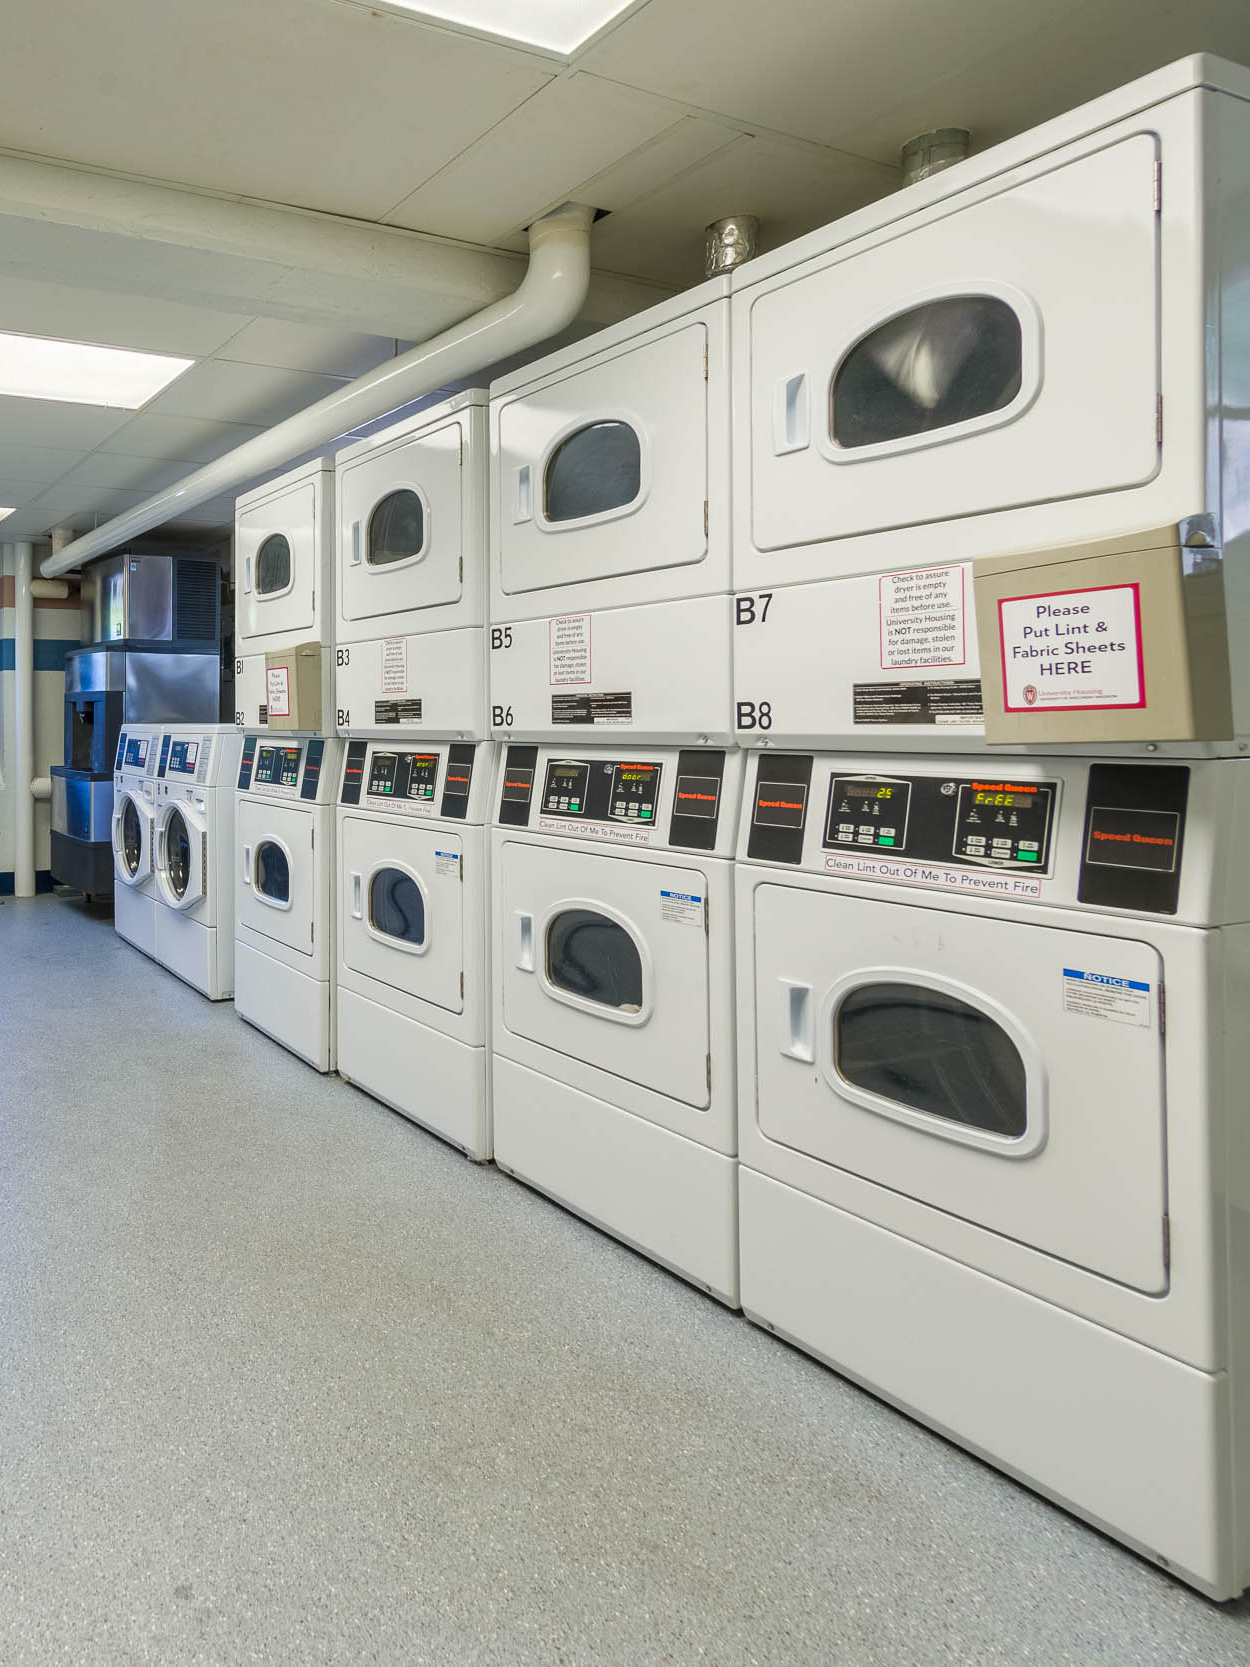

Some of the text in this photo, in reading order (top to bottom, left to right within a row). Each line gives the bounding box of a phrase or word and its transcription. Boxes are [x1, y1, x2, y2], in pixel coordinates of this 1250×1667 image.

[892, 573, 914, 584] Check
[924, 570, 950, 580] assure
[894, 585, 914, 594] dryer
[922, 581, 947, 590] empty
[908, 594, 923, 602] free
[934, 592, 948, 600] any
[736, 593, 772, 625] B7
[912, 602, 936, 612] before
[1036, 604, 1090, 618] Please
[886, 614, 956, 626] University Housing
[894, 627, 912, 636] NOT
[913, 624, 956, 634] responsible
[1023, 622, 1108, 638] Put Lint &
[492, 627, 512, 650] B5
[932, 634, 955, 643] stolen
[336, 648, 350, 666] B3
[912, 646, 932, 654] items
[1012, 642, 1126, 658] Fabric Sheets
[236, 660, 244, 674] B1
[892, 658, 918, 666] laundry
[1040, 660, 1092, 676] HERE
[236, 712, 244, 726] B2
[338, 710, 350, 726] B4
[492, 706, 514, 726] B6
[736, 701, 772, 730] B8
[878, 788, 892, 798] 25
[972, 782, 1038, 792] Speed Queen
[1094, 831, 1173, 846] Speed Queen
[826, 858, 1038, 894] Clean Lint Out Of Me To Prevent Fire
[1083, 972, 1130, 988] NOTICE
